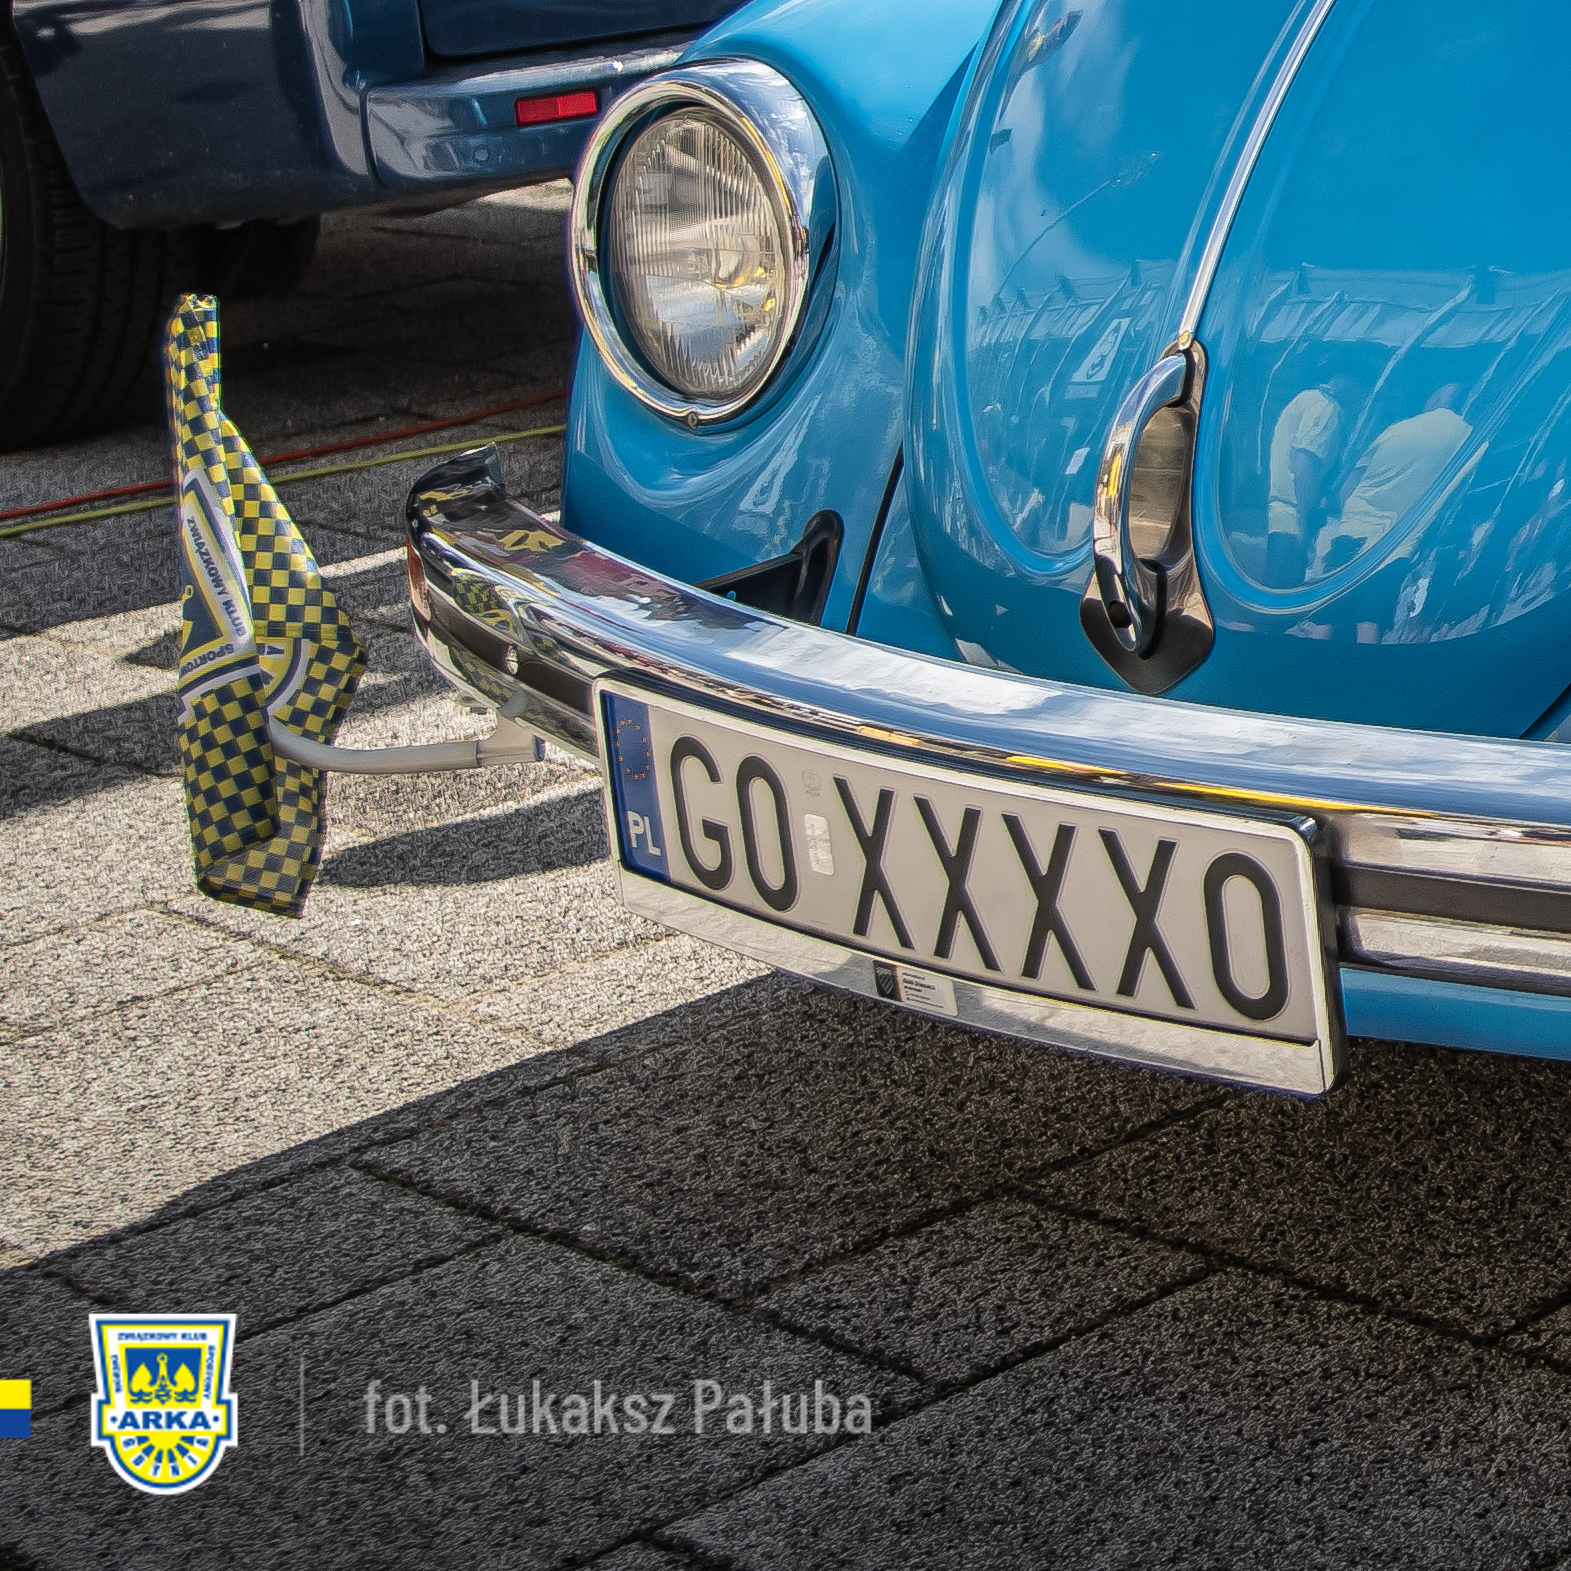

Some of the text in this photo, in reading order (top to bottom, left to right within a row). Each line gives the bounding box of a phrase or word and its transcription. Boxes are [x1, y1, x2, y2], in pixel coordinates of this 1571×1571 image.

[187, 515, 228, 597] ZWIĄZKOWY
[181, 643, 235, 679] SPORTOW
[626, 810, 662, 857] PL
